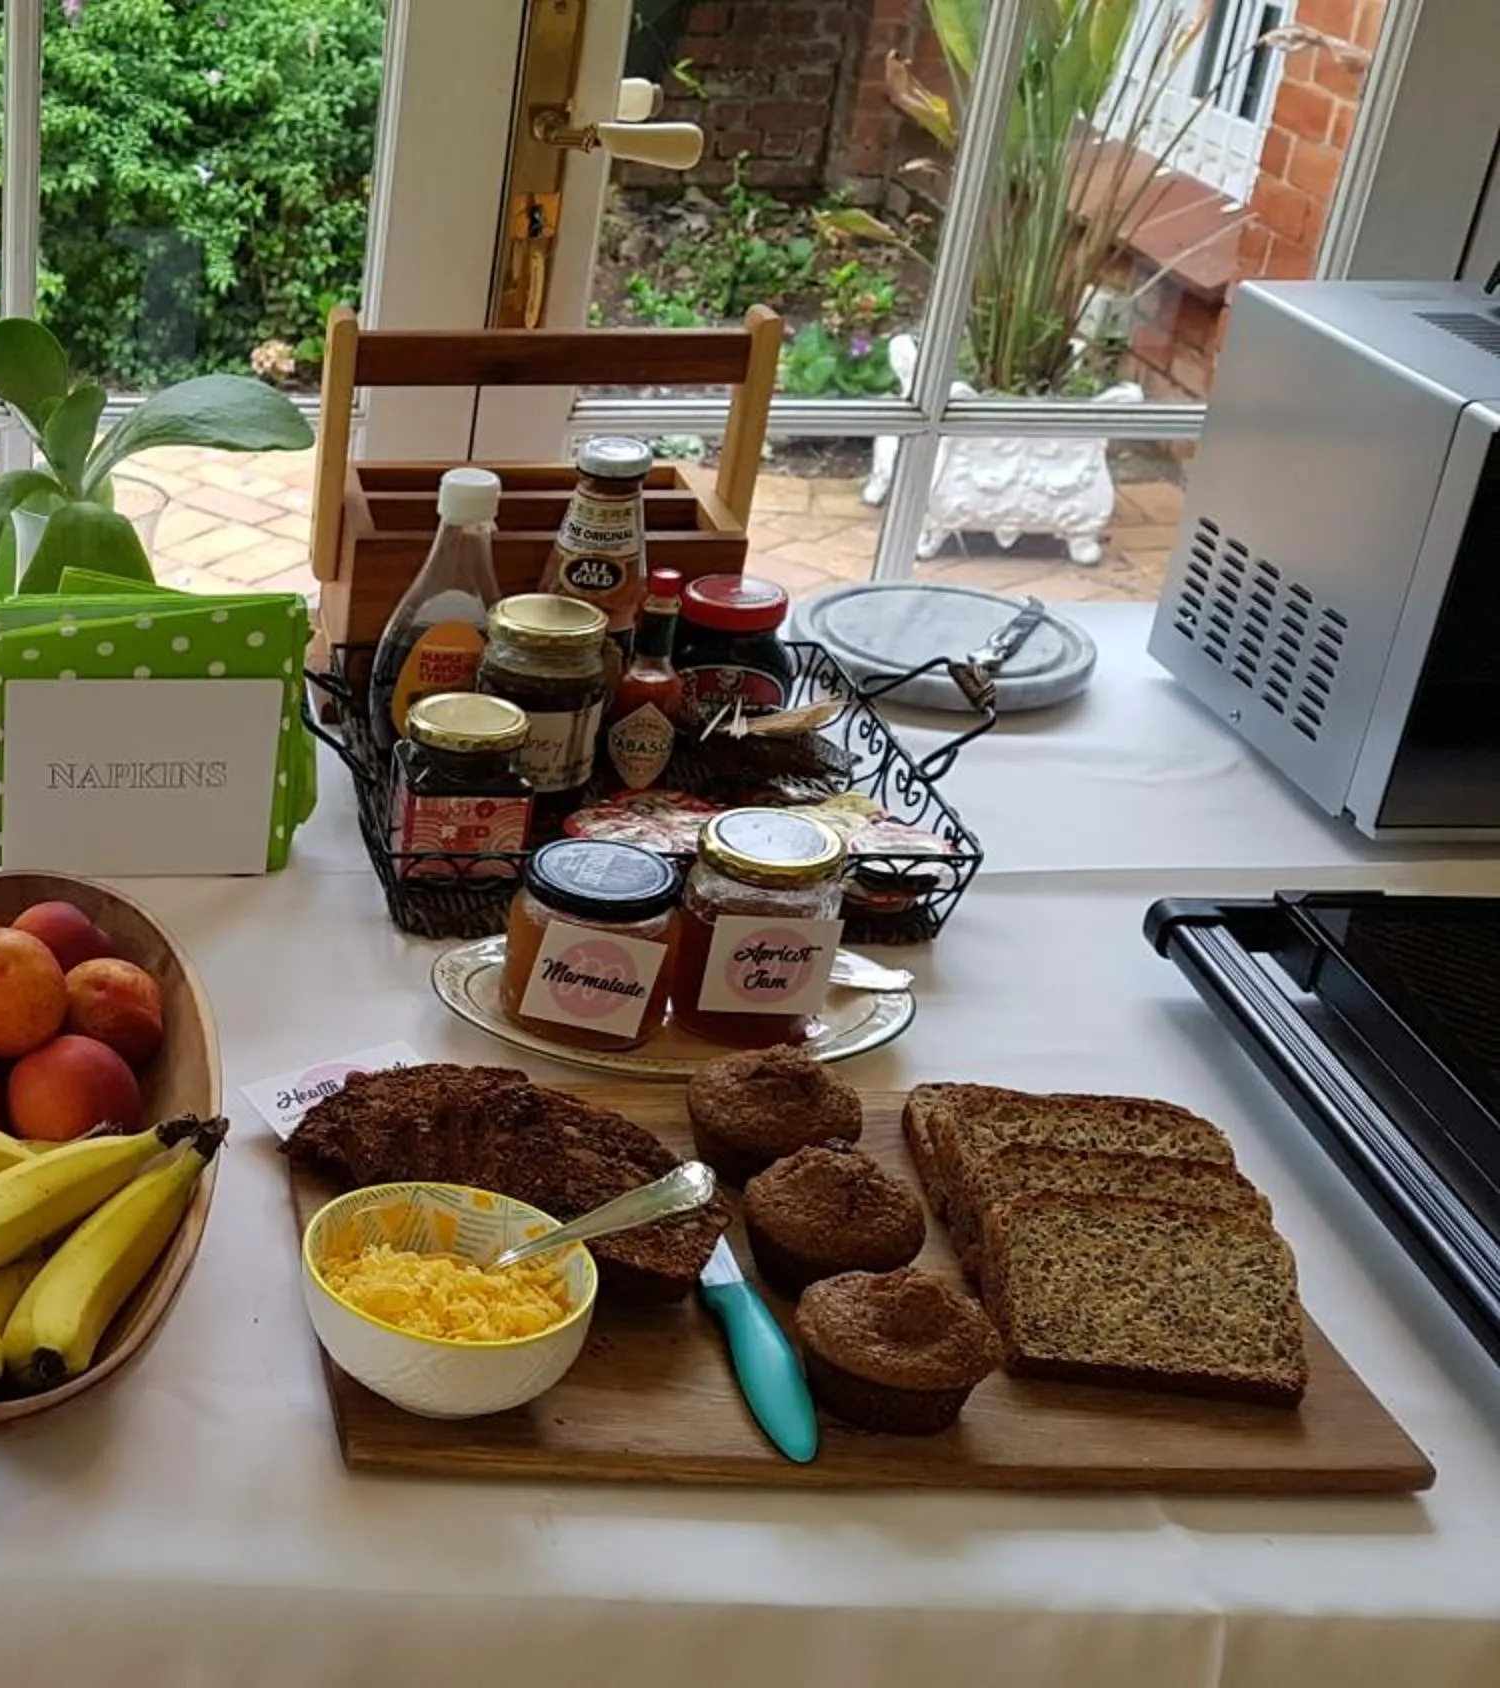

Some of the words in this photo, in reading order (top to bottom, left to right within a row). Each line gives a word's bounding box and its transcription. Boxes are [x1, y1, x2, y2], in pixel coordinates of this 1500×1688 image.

[583, 529, 633, 541] ORIGINAL
[571, 571, 614, 586] GOLD
[580, 561, 609, 574] ALL
[47, 761, 228, 790] NAPKINS
[733, 940, 824, 968] Apricot
[542, 957, 647, 999] Marmalade
[743, 969, 789, 992] Jam
[276, 1078, 340, 1109] Health
